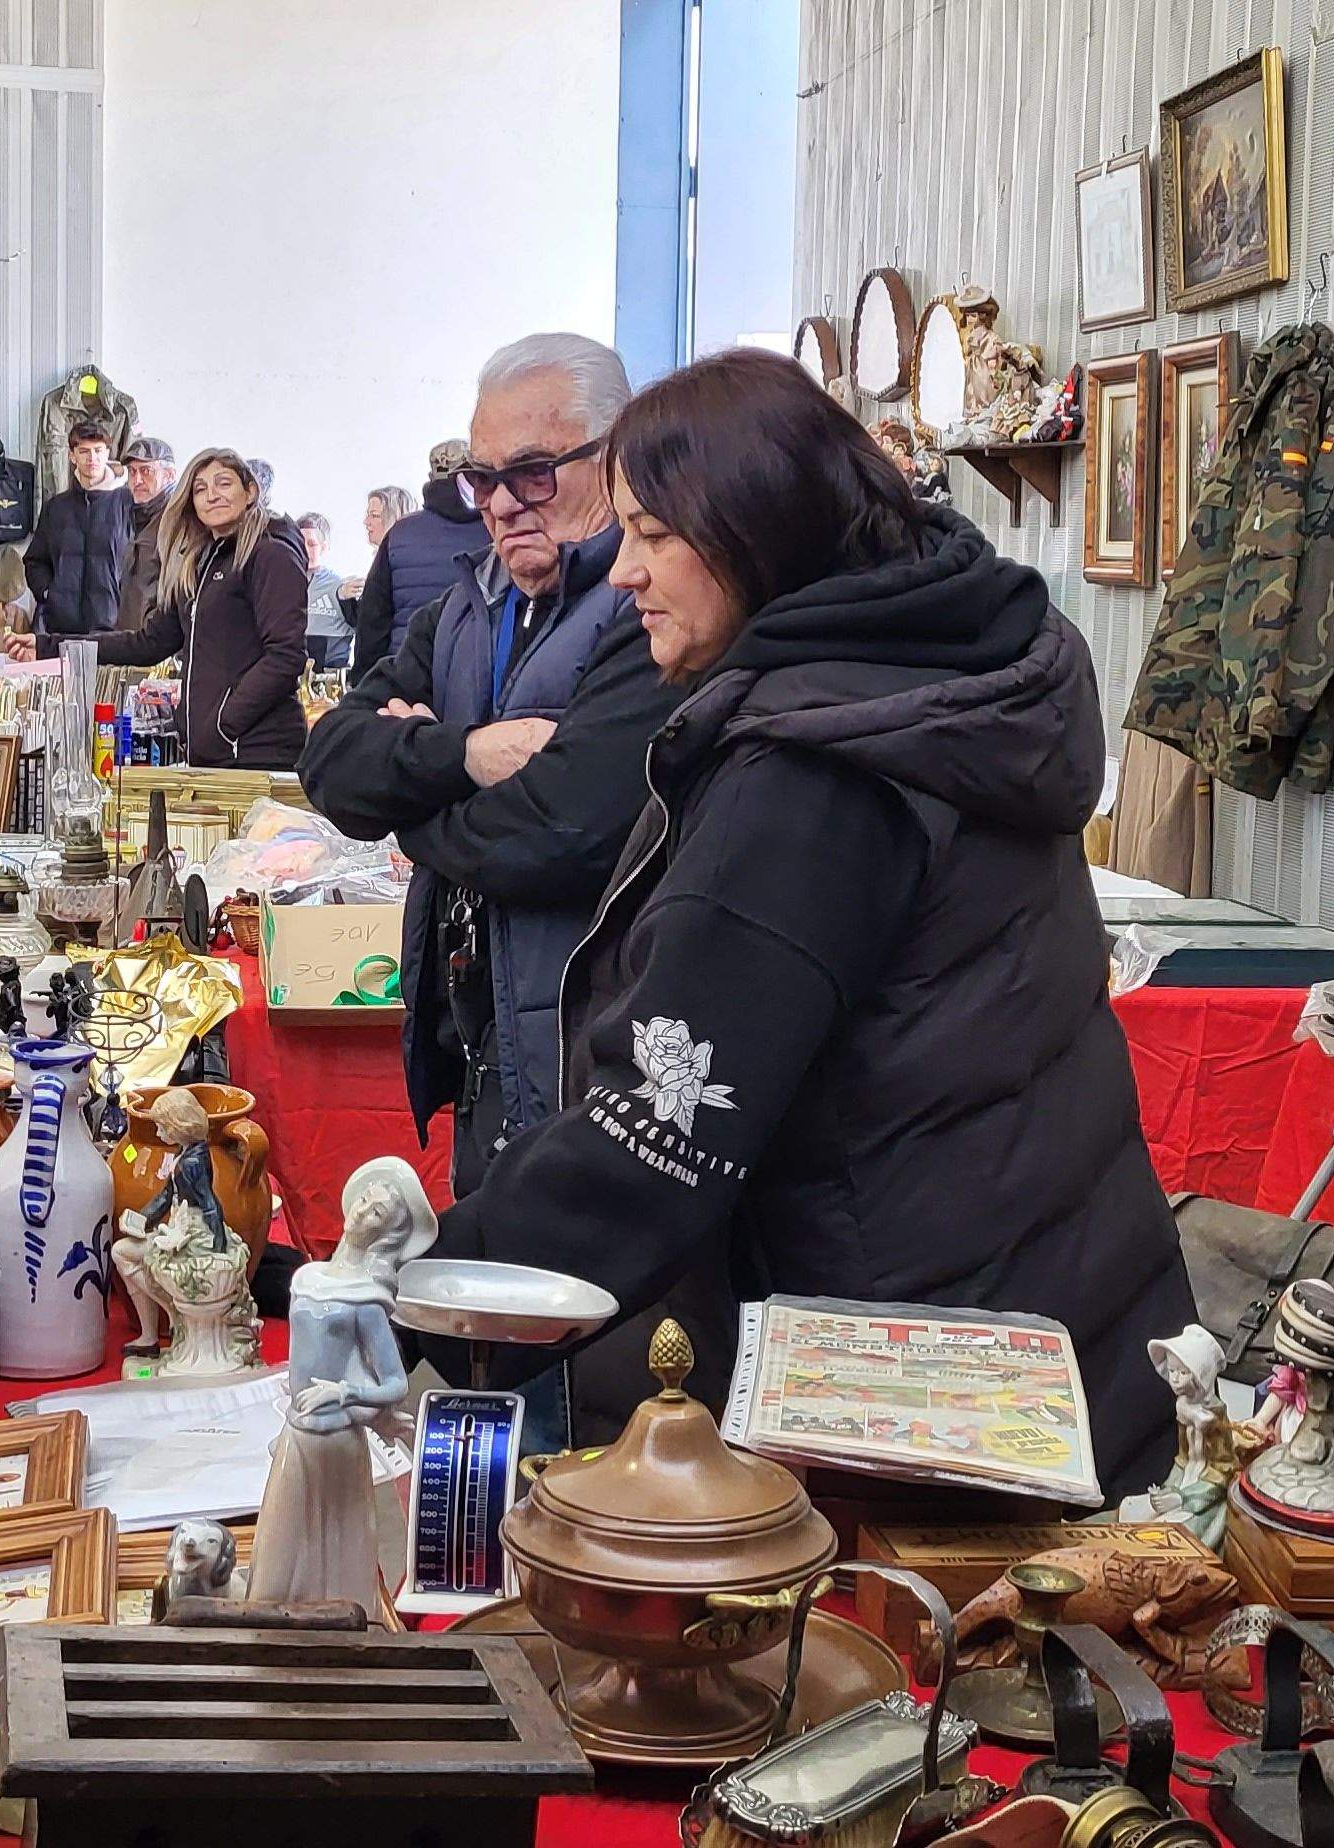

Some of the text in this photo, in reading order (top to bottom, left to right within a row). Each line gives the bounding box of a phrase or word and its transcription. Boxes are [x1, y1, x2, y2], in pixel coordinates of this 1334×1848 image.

[601, 1115, 629, 1143] NOT
[634, 1117, 749, 1181] SENSITIVE
[429, 1432, 445, 1440] 100
[424, 1446, 444, 1455] 200
[423, 1462, 442, 1470] 300
[422, 1478, 441, 1486] 400
[420, 1510, 438, 1518] 600
[419, 1527, 437, 1535] 700
